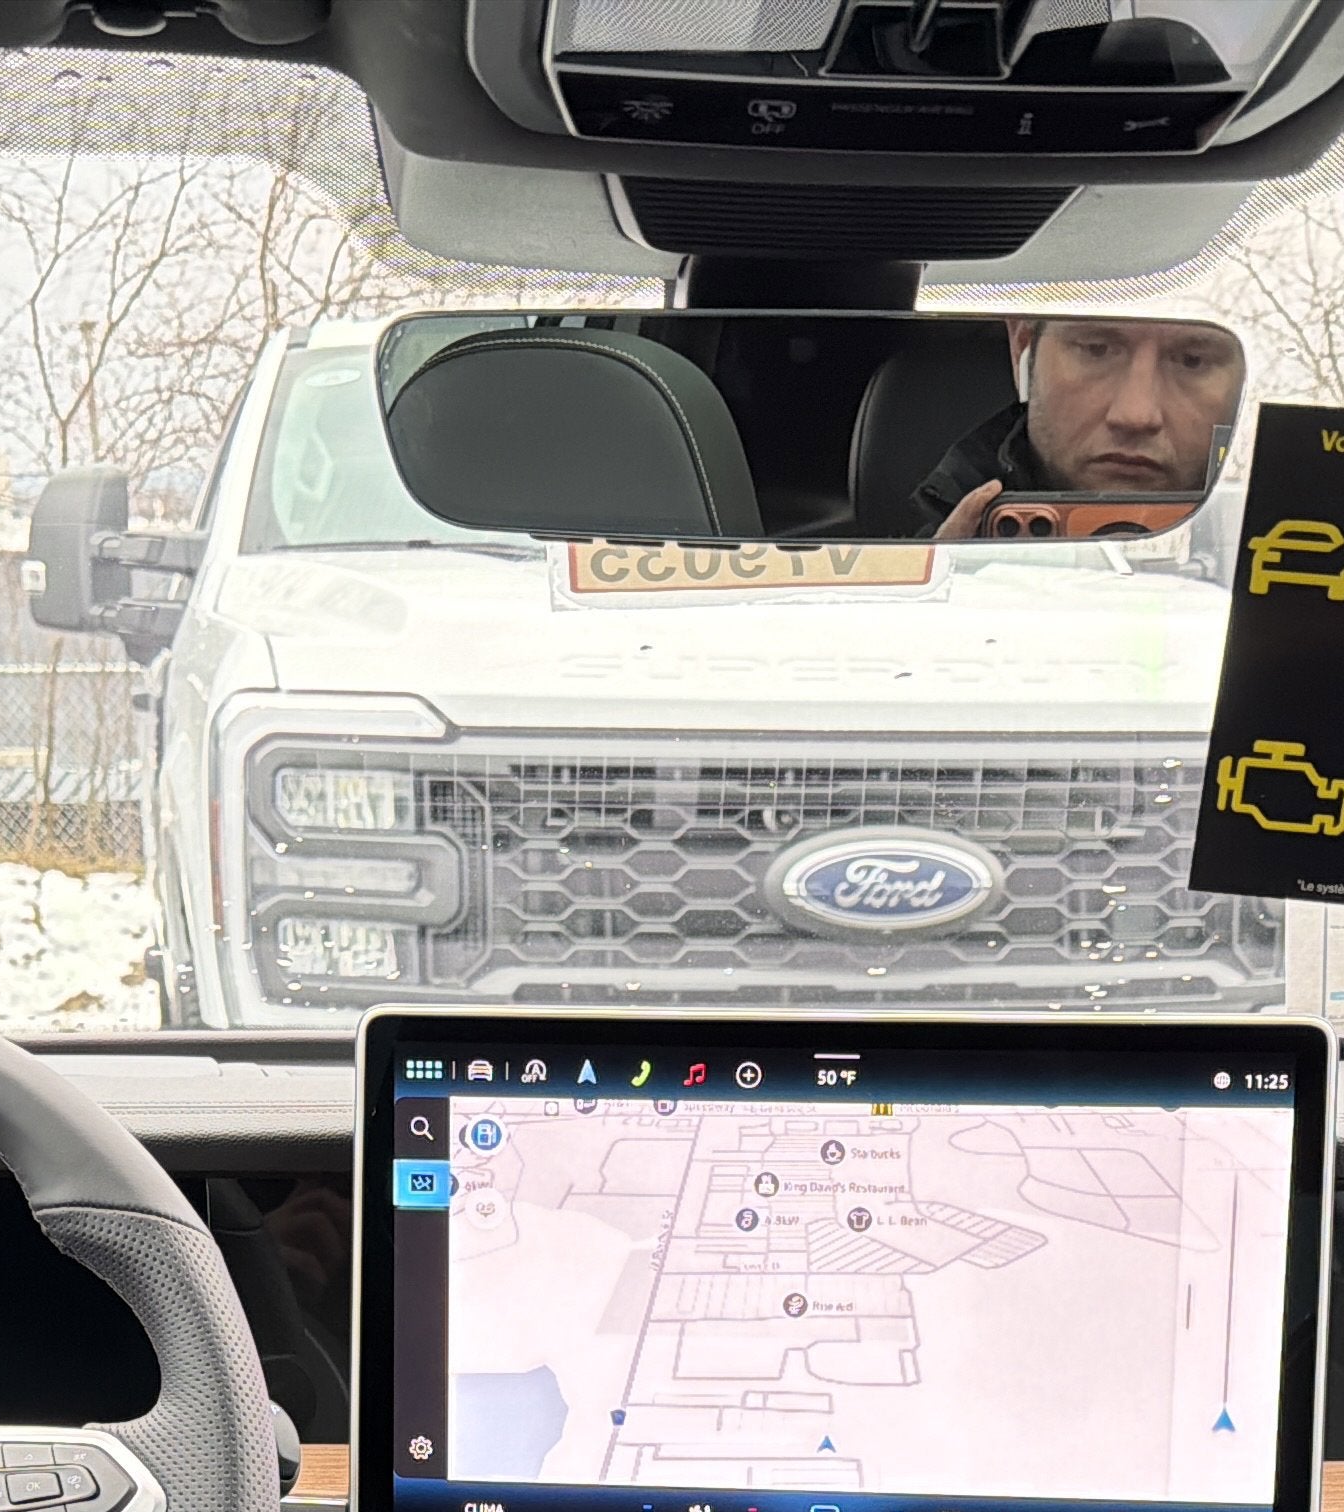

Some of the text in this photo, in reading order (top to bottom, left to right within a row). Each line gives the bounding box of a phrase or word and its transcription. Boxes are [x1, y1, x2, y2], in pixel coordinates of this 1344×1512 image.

[835, 857, 943, 909] Ford
[816, 1070, 837, 1085] 50
[1244, 1073, 1290, 1090] 11:25
[26, 1481, 41, 1491] OK
